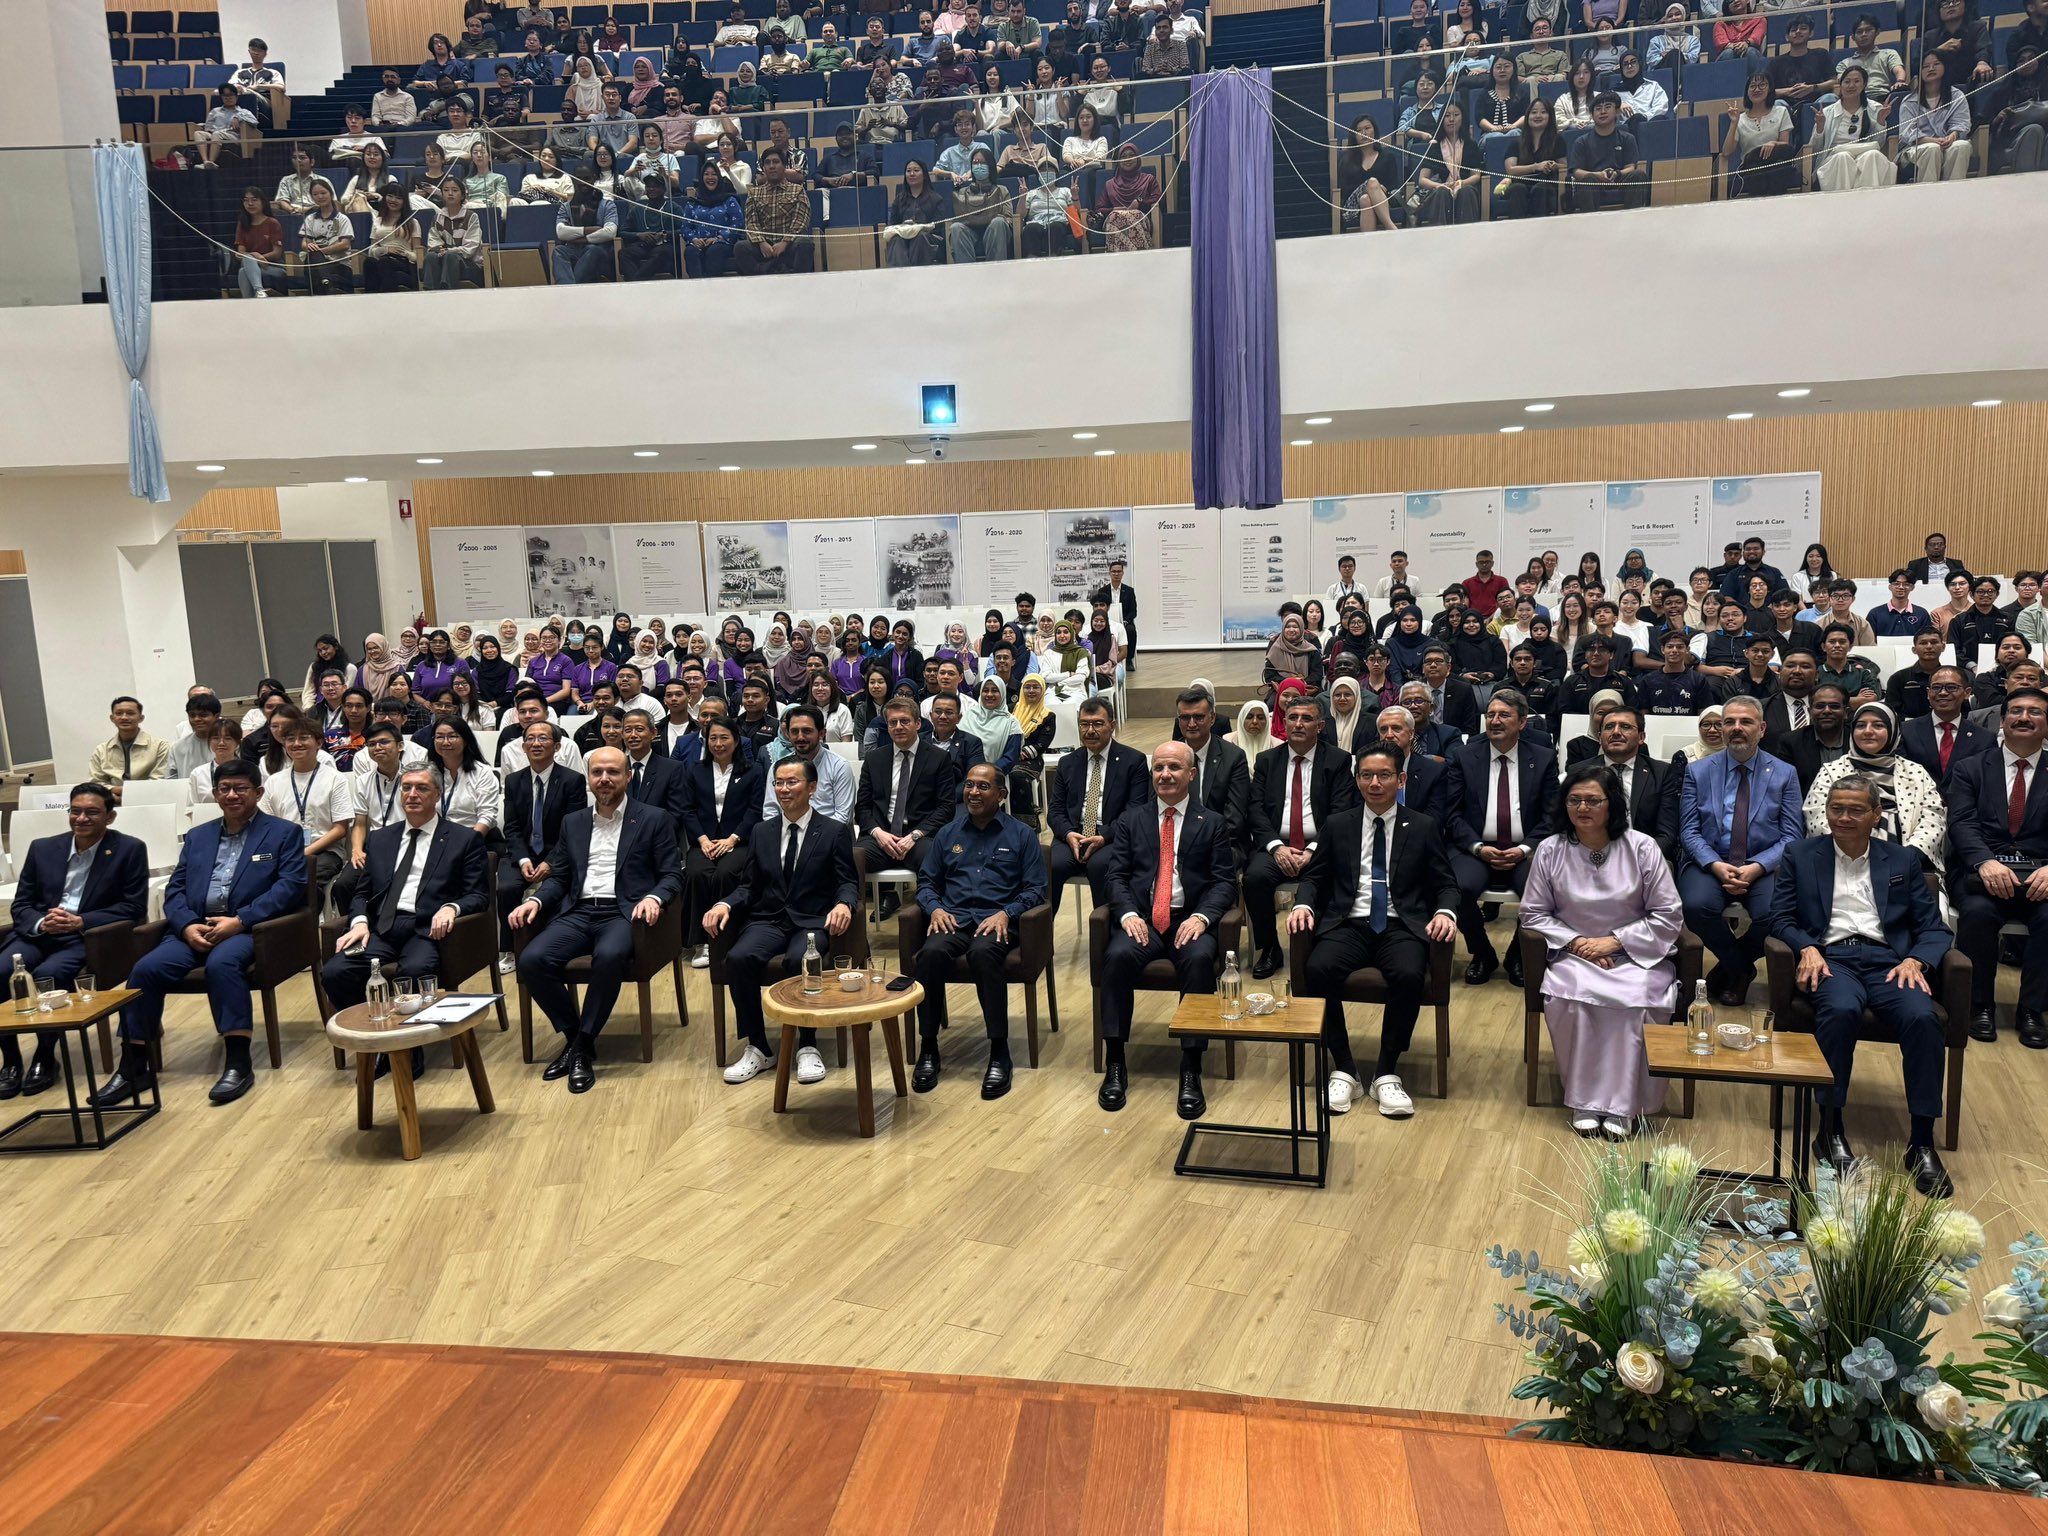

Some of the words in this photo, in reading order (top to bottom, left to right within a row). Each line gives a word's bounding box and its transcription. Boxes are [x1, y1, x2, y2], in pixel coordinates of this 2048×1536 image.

[1720, 482, 1729, 491] G
[1613, 487, 1621, 495] T
[1511, 491, 1519, 500] C
[1413, 497, 1421, 505] A
[1430, 530, 1466, 538] Accountability
